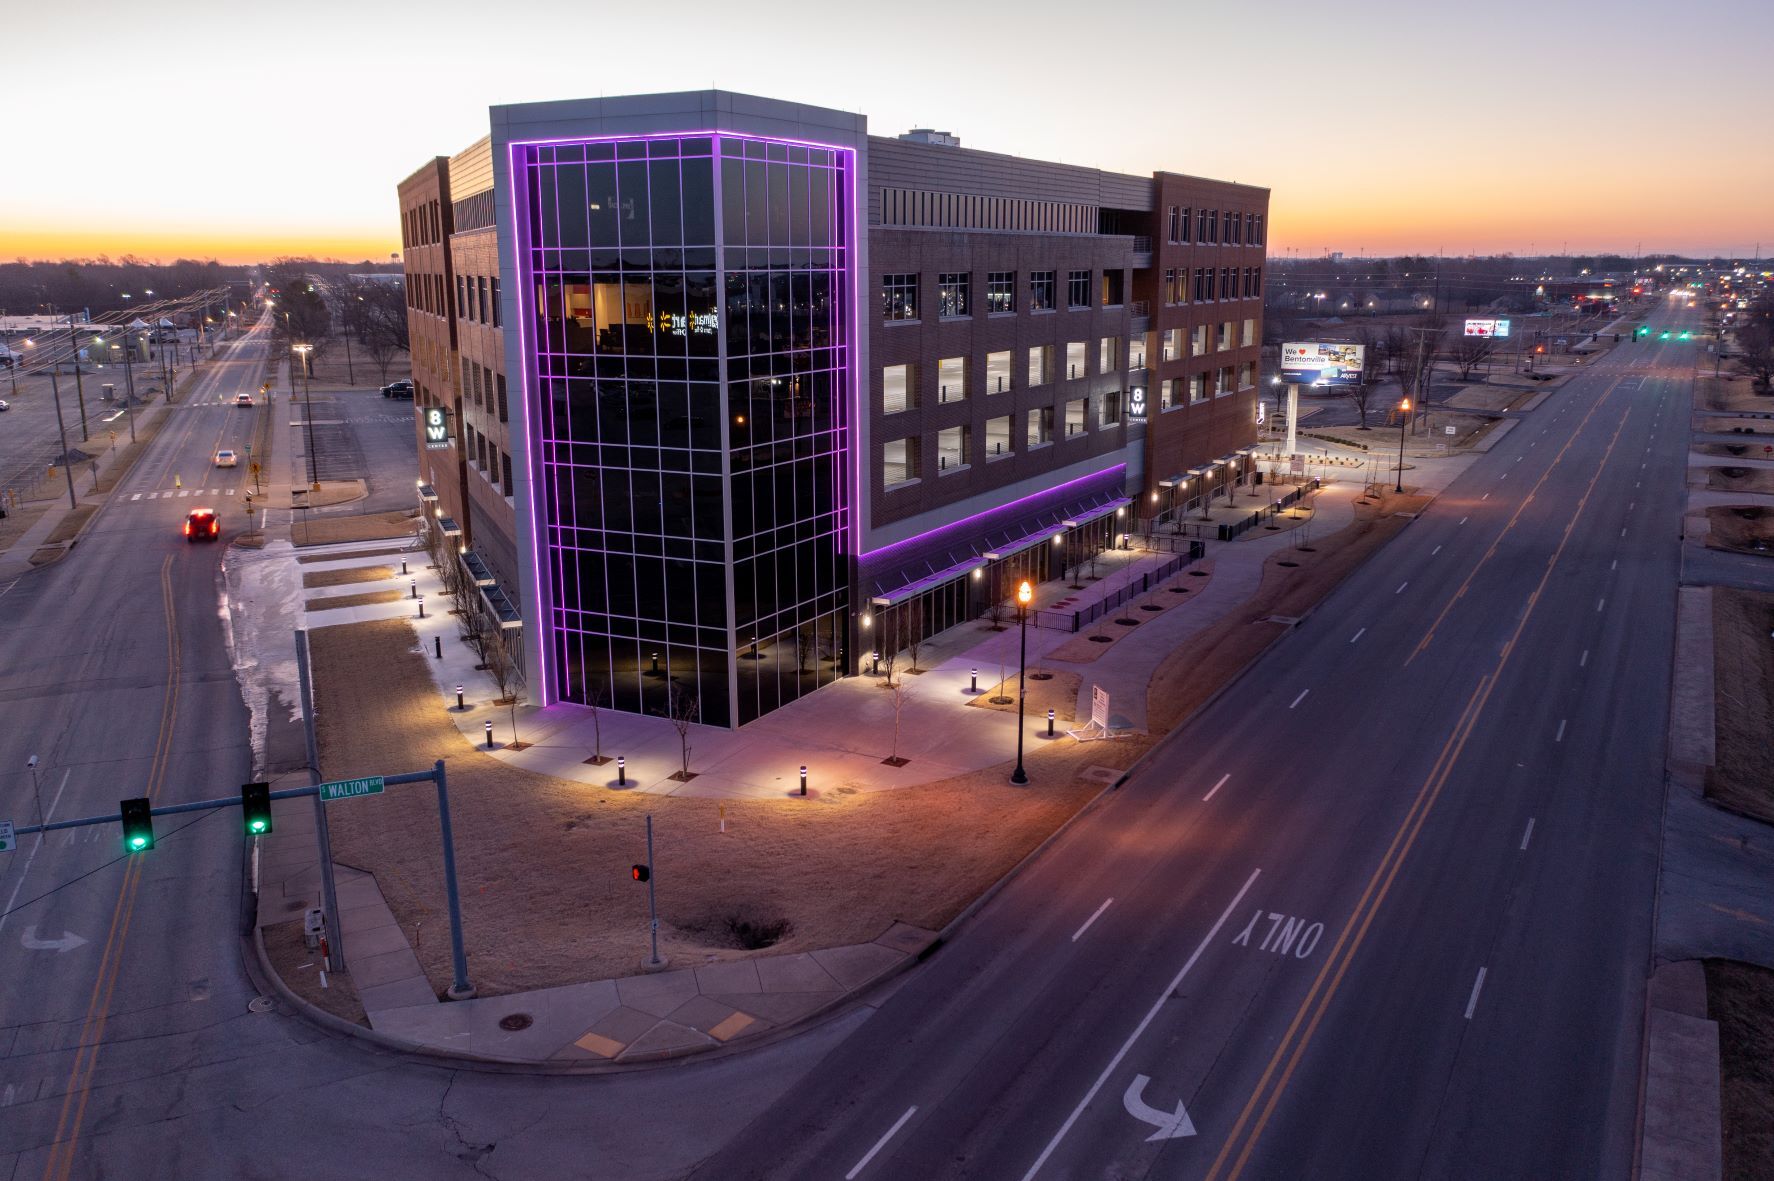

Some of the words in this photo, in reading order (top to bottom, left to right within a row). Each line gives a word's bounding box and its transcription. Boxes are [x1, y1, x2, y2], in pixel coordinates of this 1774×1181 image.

[1284, 355, 1326, 363] Bentonville
[1134, 388, 1143, 402] 8
[1130, 403, 1146, 414] W
[430, 410, 442, 425] 8
[427, 426, 446, 440] W
[328, 781, 369, 797] WALTON
[1231, 909, 1325, 959] ONLY
